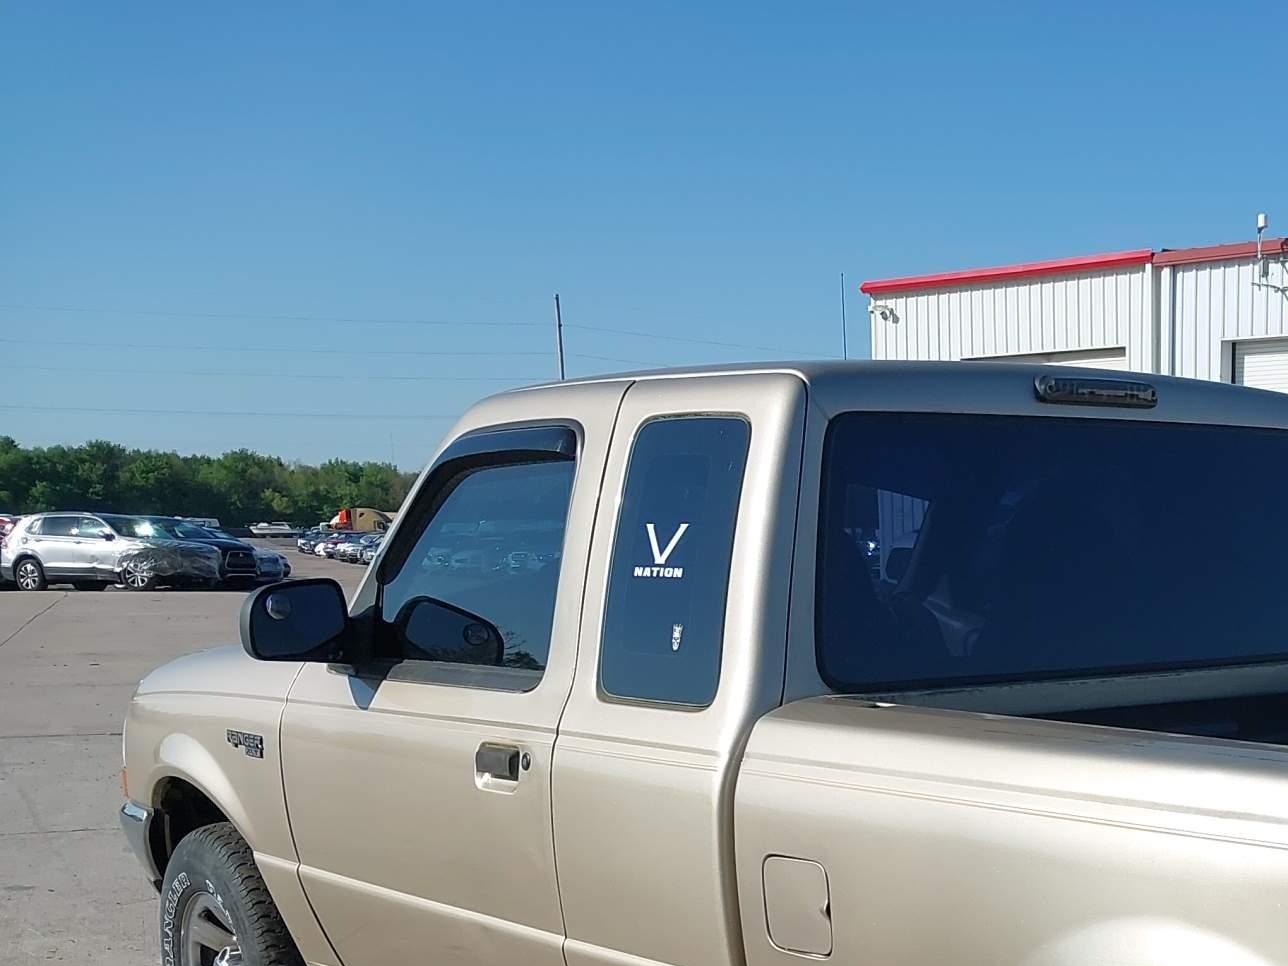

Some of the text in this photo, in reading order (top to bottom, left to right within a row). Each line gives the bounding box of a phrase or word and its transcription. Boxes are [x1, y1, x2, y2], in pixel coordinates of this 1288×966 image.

[646, 523, 690, 565] V
[633, 566, 683, 578] NATION
[226, 729, 264, 750] RANGER
